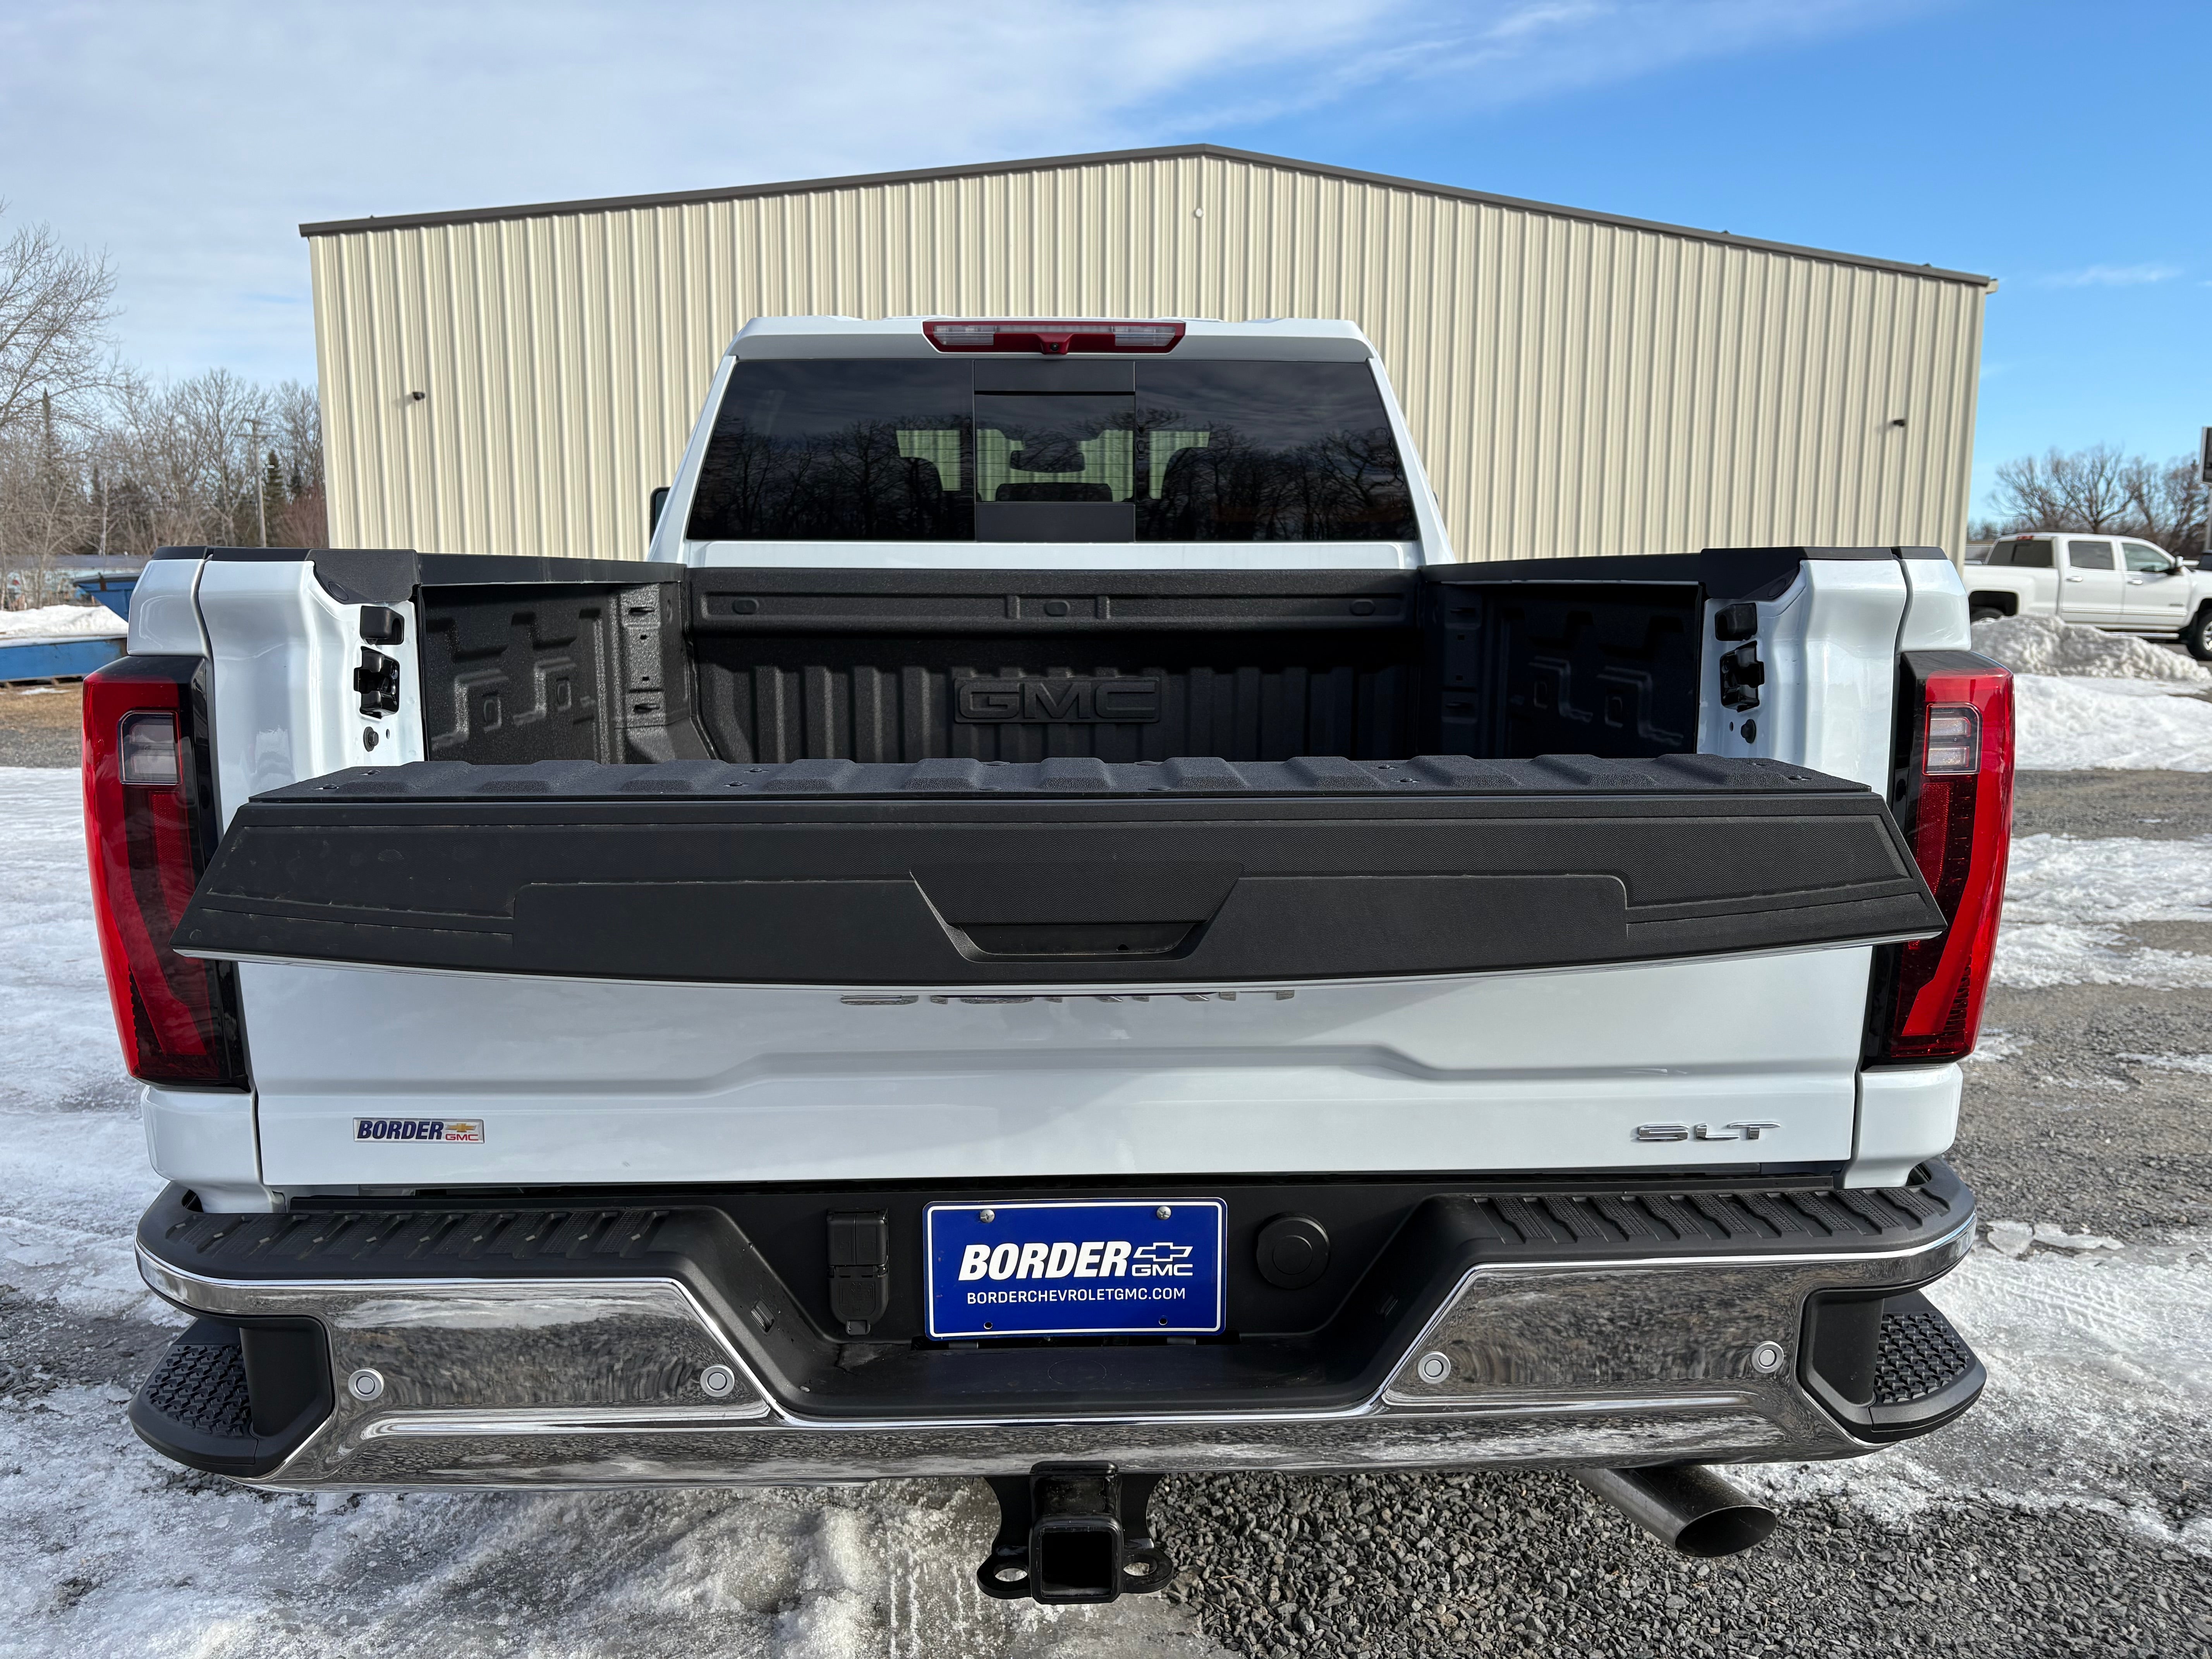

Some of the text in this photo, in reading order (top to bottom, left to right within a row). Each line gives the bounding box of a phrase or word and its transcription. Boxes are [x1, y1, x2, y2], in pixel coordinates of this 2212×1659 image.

[959, 682, 1156, 719] GMC
[357, 1120, 444, 1140] BORDER
[1637, 1121, 1781, 1141] SLT
[958, 1241, 1194, 1281] BORDER GMC
[967, 1287, 1186, 1305] BORDERCHEVROLETGMC.COM
